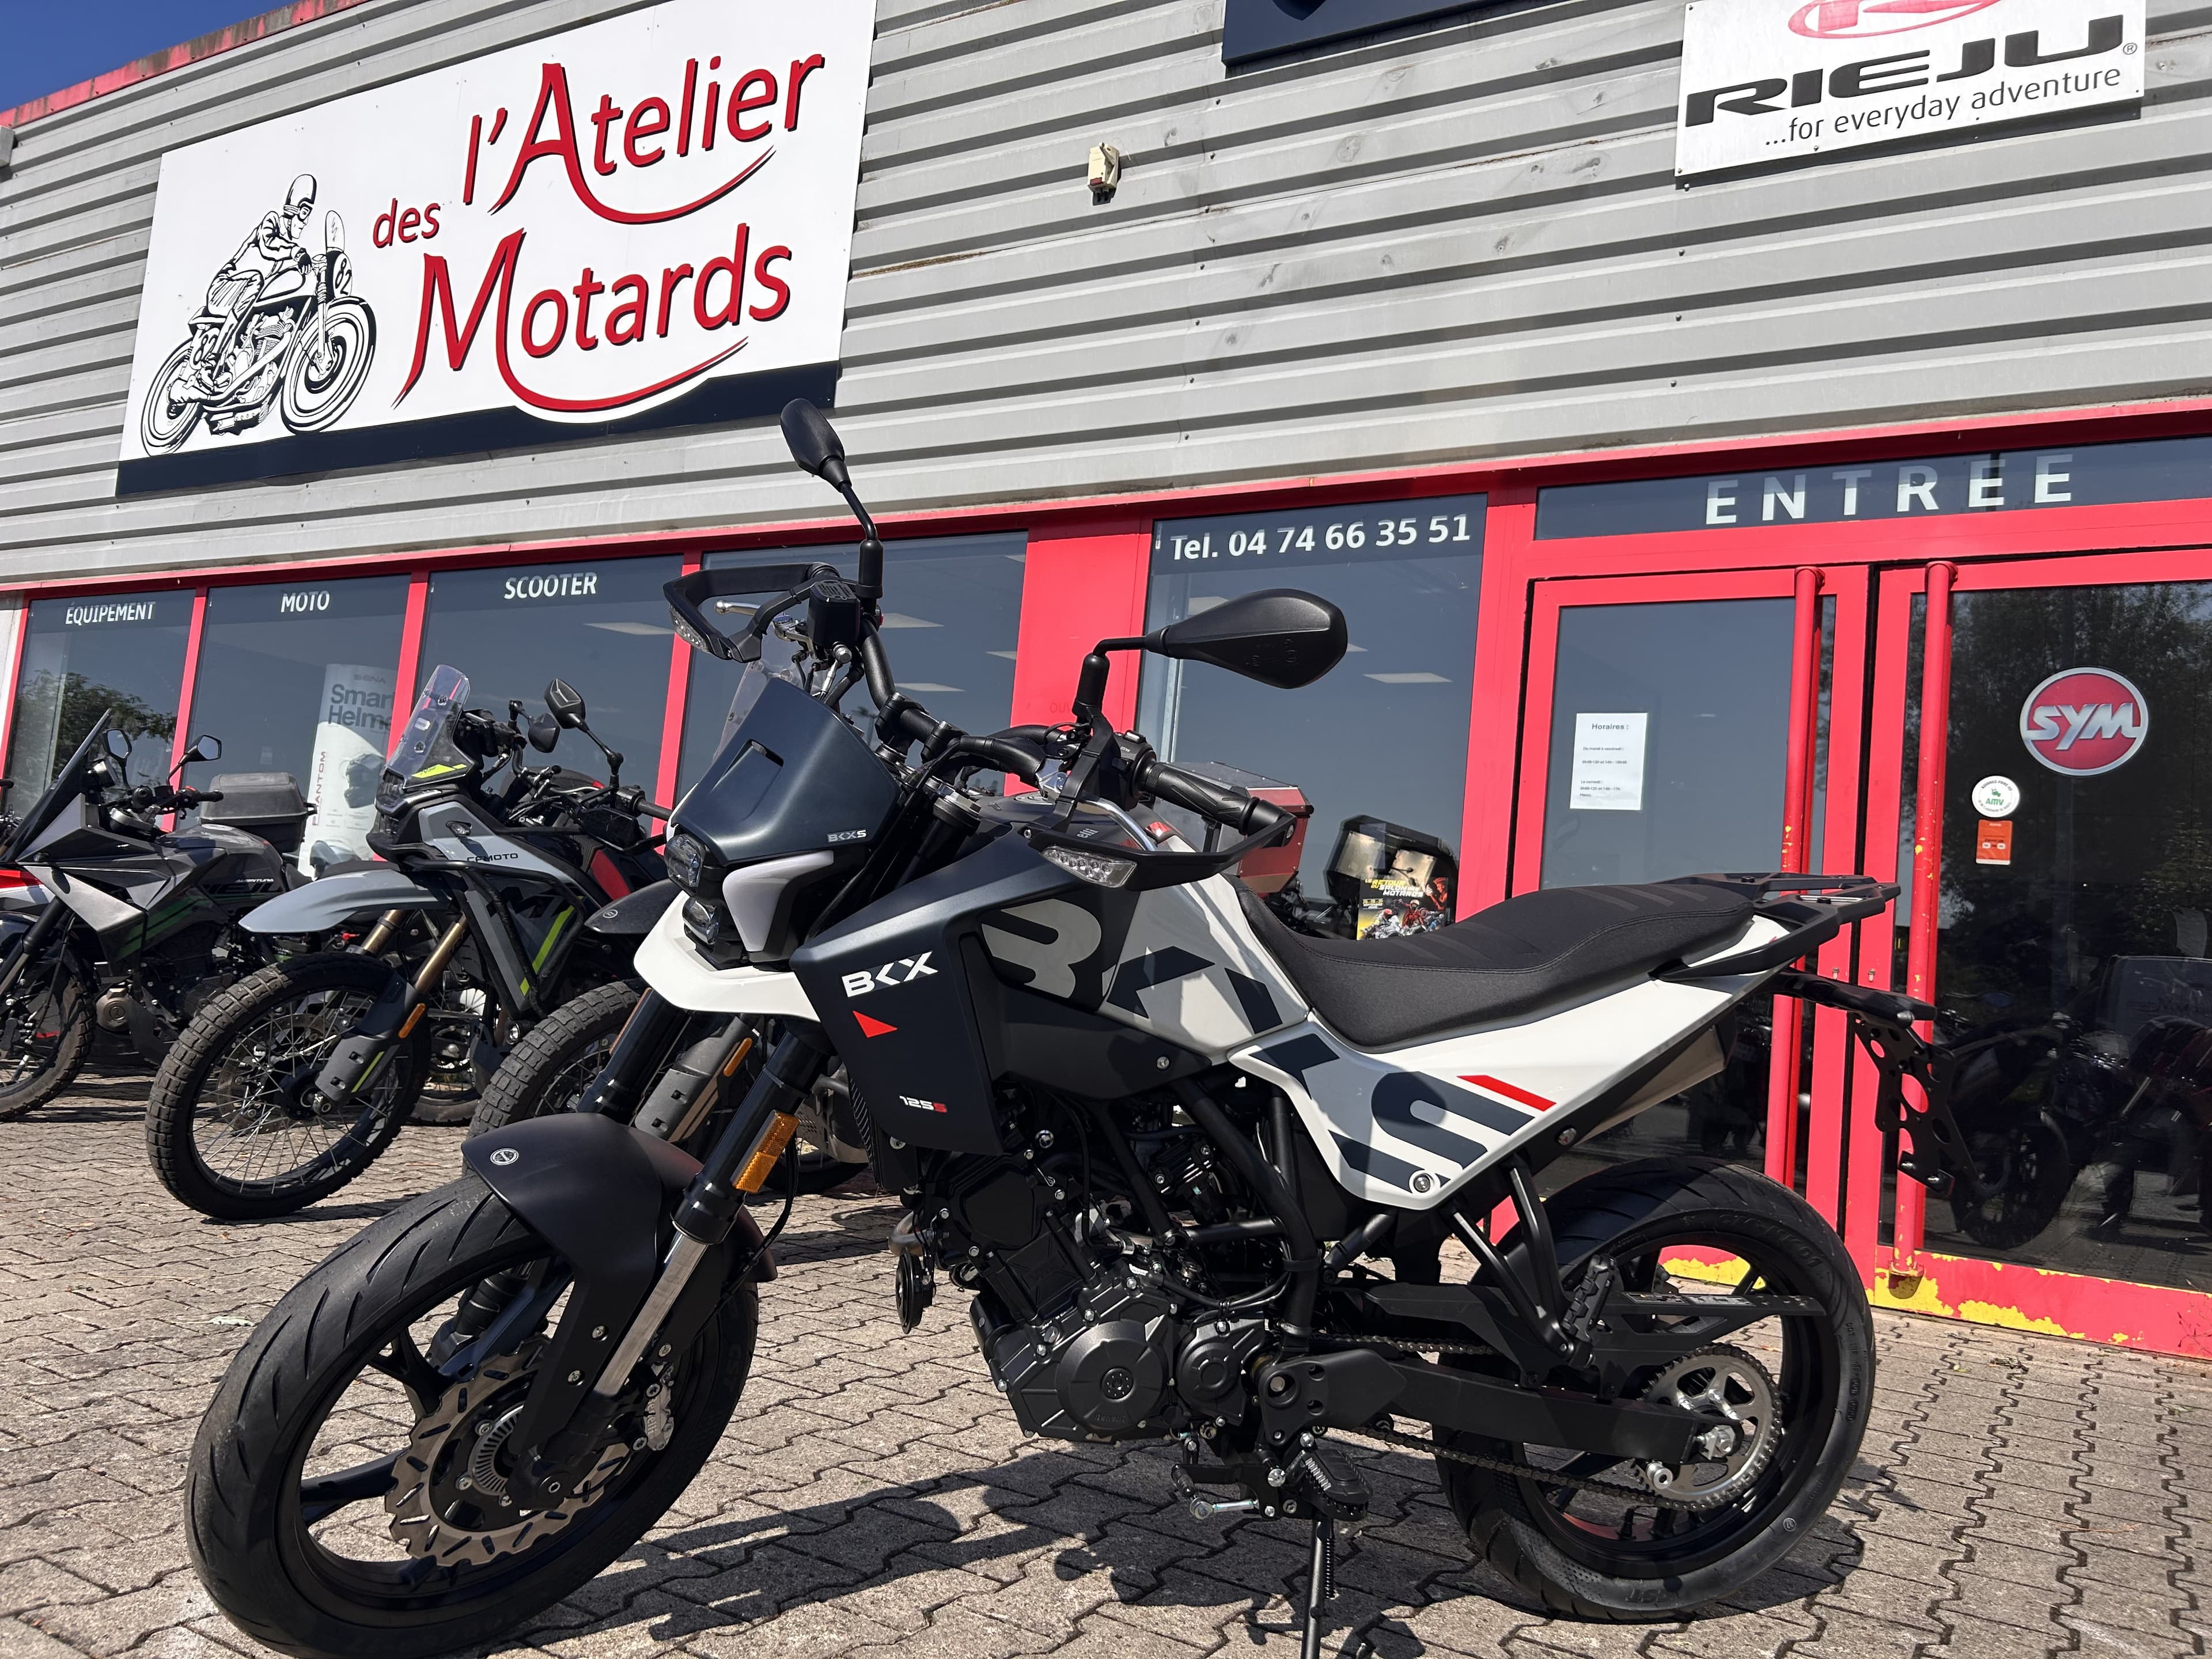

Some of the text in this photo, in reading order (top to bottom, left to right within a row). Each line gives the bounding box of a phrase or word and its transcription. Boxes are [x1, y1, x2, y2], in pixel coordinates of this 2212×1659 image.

[1684, 14, 2124, 127] RIEJU
[1834, 96, 1961, 134] everyday
[1971, 65, 2122, 111] adventure
[372, 198, 441, 249] des
[335, 259, 351, 295] 82
[391, 222, 793, 412] Motards
[1170, 513, 1471, 560] Tel. 04 74 66 35 51
[281, 590, 331, 613] MOTO
[503, 571, 598, 600] SCOOTER
[65, 600, 157, 626] ÉQUIPEMENT
[331, 684, 395, 709] Smar
[2025, 703, 2138, 750] SYM
[312, 751, 327, 826] PANTOM
[1077, 828, 1099, 838] elli
[467, 853, 519, 863] CFMOTO
[1382, 889, 1425, 897] MOTARDS
[842, 951, 938, 998] BKX
[899, 1095, 948, 1113] 125S
